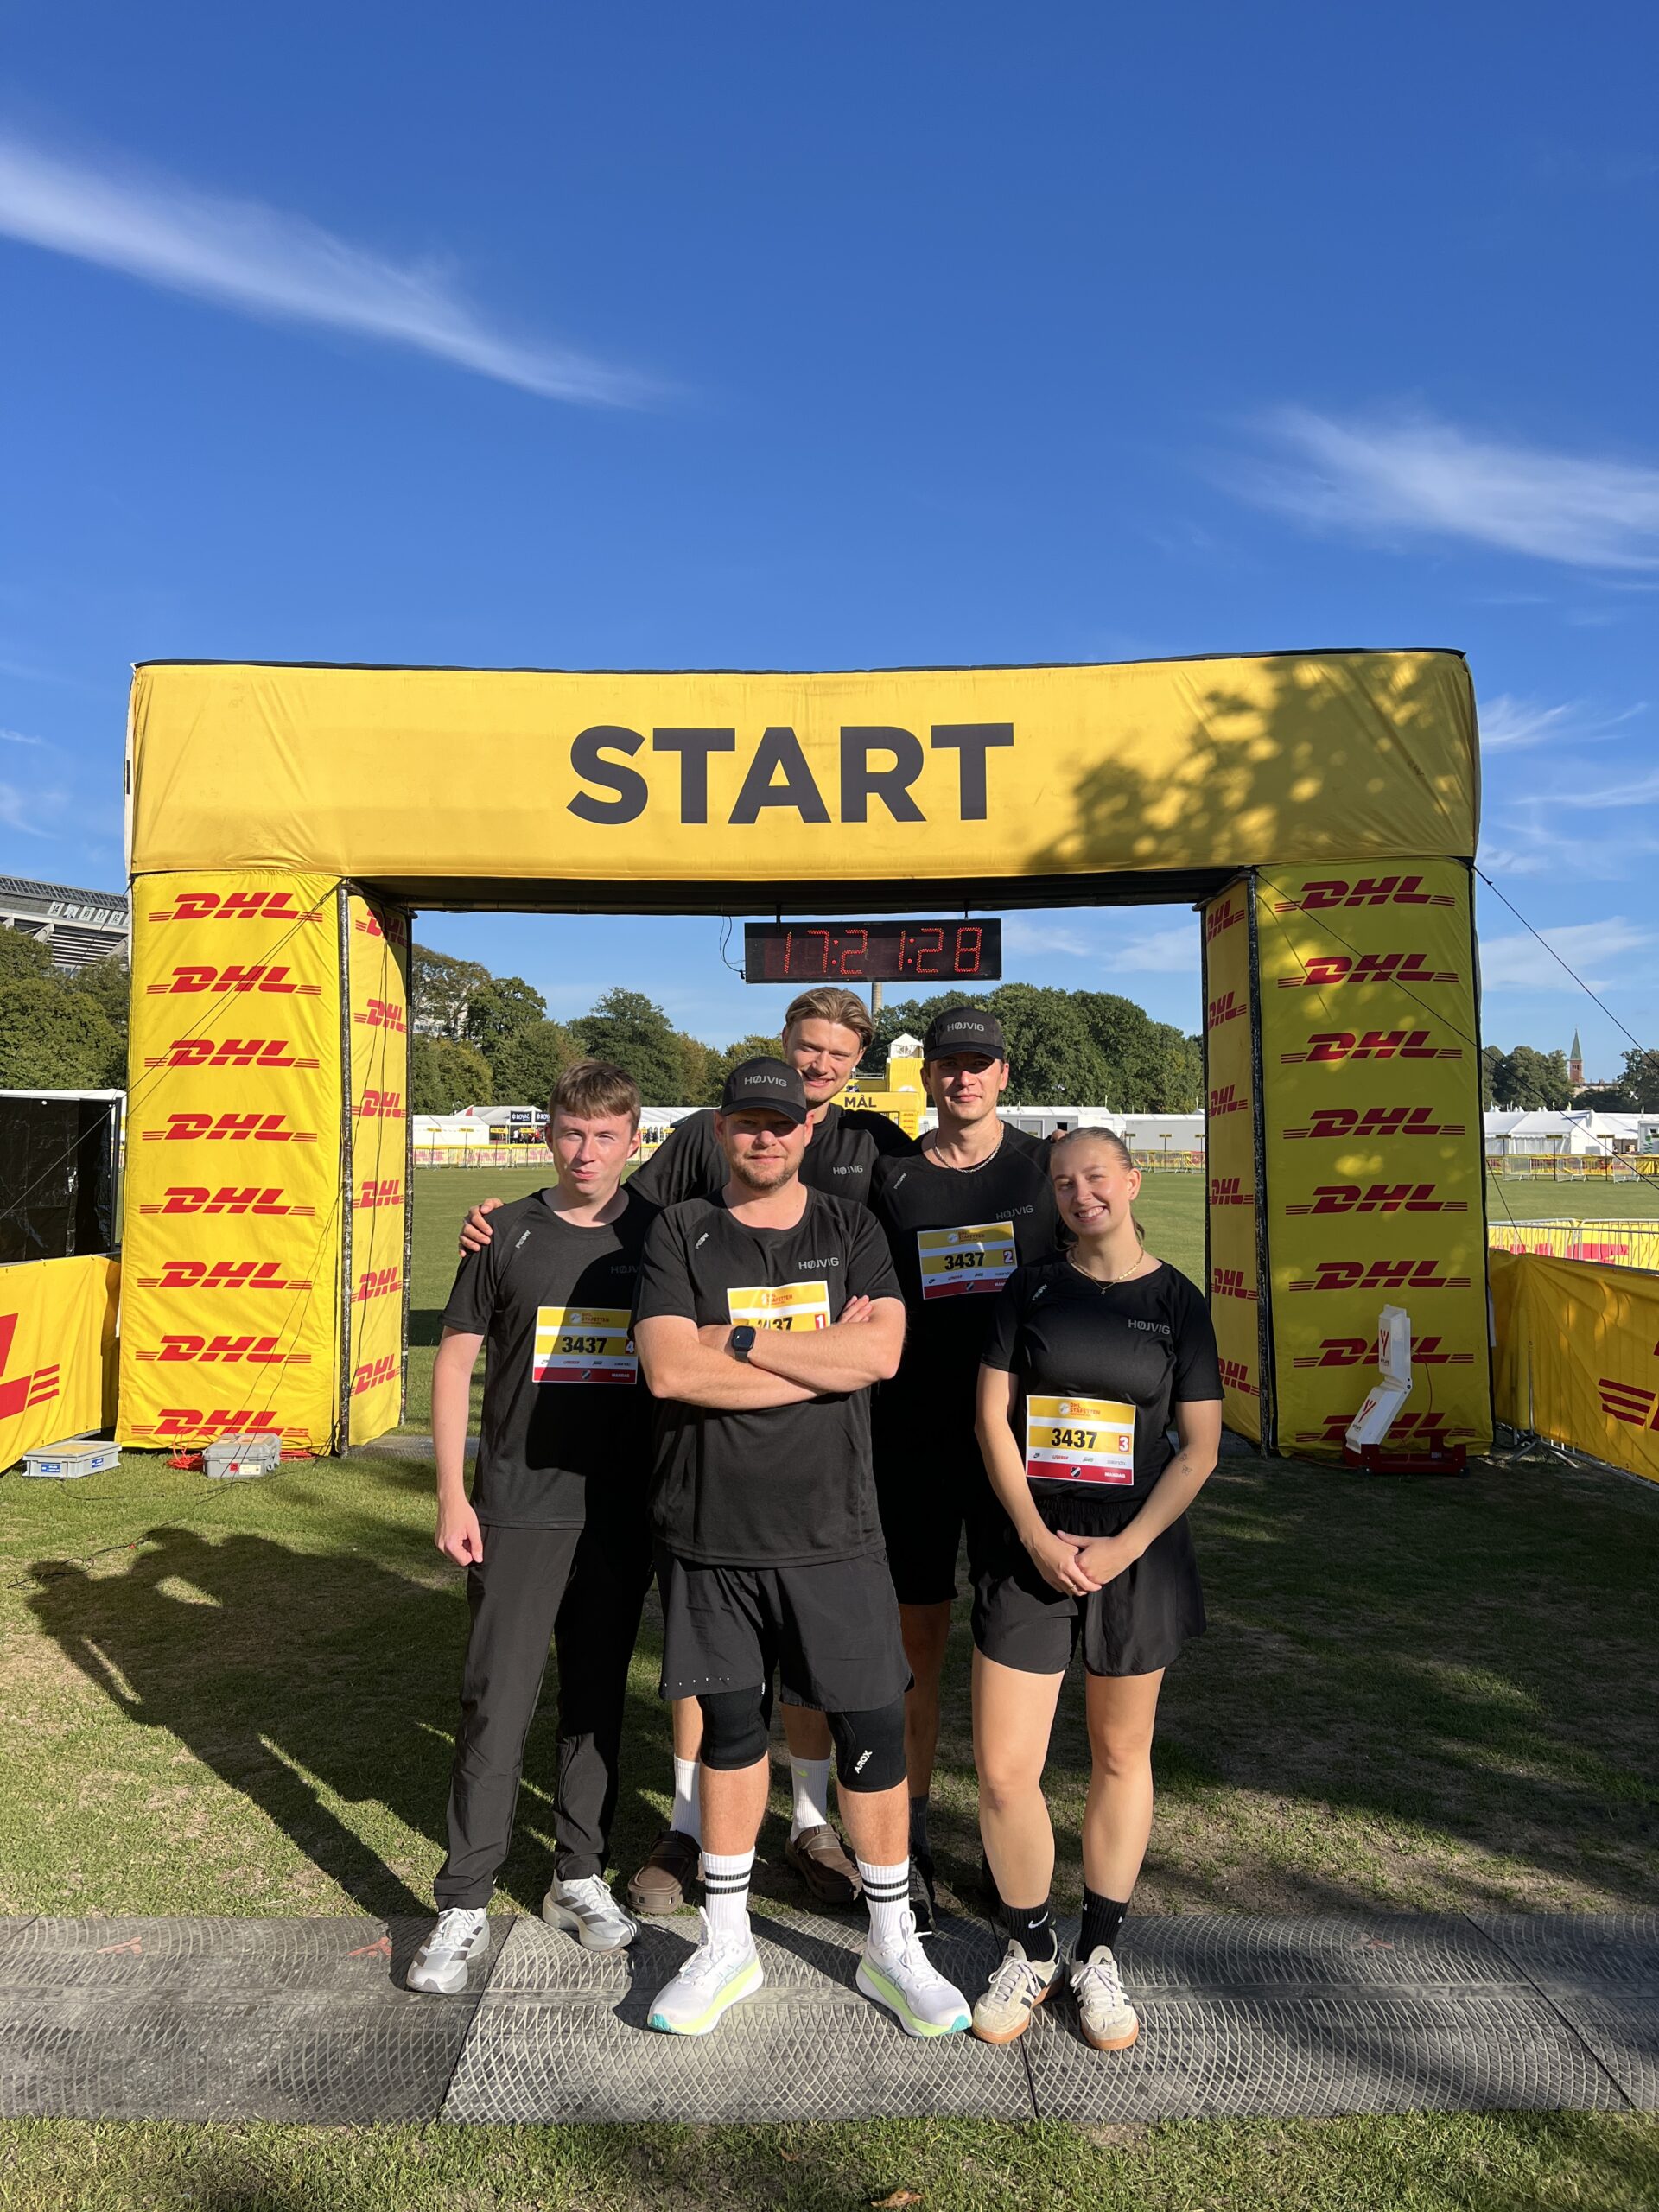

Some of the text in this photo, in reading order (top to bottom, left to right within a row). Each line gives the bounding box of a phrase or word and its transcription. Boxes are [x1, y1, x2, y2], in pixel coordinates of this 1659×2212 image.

[566, 722, 1014, 825] START
[174, 892, 298, 919] DHL
[1301, 876, 1431, 910] DHL
[784, 927, 982, 975] 17:21:28
[171, 966, 296, 994] DHL
[1304, 953, 1434, 986] DHL
[366, 999, 404, 1033] DHL
[946, 1021, 985, 1032] HØJVIG
[168, 1039, 294, 1067] DHL
[1306, 1030, 1438, 1061] DHL
[744, 1075, 787, 1087] HØJVIG
[361, 1090, 402, 1118] DHL
[844, 1094, 877, 1108] MÅL
[166, 1114, 291, 1141] DHL
[1309, 1107, 1440, 1138] DHL
[832, 1165, 864, 1175] HØJVIG
[163, 1187, 289, 1214] DHL
[359, 1179, 400, 1208] DHL
[1312, 1184, 1443, 1214] DHL
[995, 1205, 1034, 1220] HØJVIG
[610, 1264, 639, 1274] HØJV
[798, 1256, 840, 1270] HØJVIG
[944, 1251, 985, 1271] 3437
[1003, 1249, 1014, 1263] 2
[161, 1262, 287, 1289] DHL
[357, 1266, 397, 1301] DHL
[1314, 1260, 1446, 1290] DHL
[815, 1314, 824, 1330] 1
[1128, 1319, 1171, 1335] HØJVIG
[159, 1336, 285, 1363] DHL
[562, 1336, 607, 1354] 3437
[626, 1340, 635, 1354] 4
[354, 1354, 396, 1395] DHL
[154, 1409, 284, 1436] DHL
[1070, 1407, 1101, 1415] STAFETTEN
[1051, 1428, 1097, 1449] 3437
[1119, 1436, 1129, 1452] 3
[855, 1750, 873, 1774] AROX
